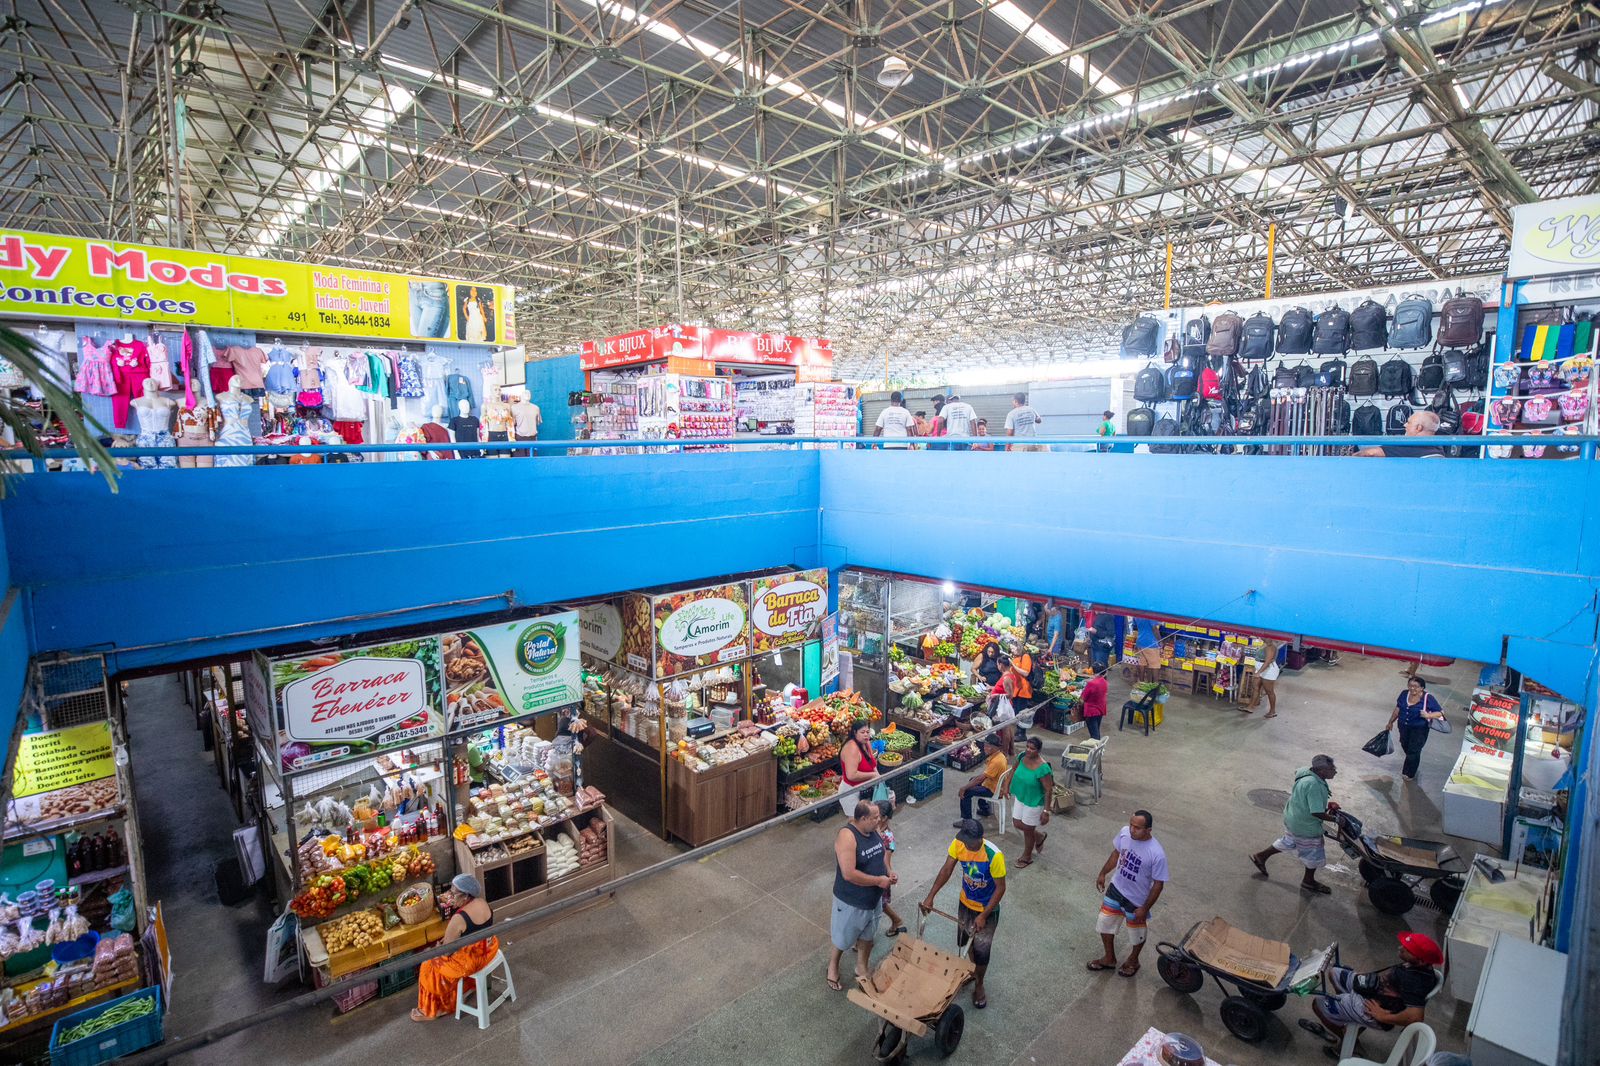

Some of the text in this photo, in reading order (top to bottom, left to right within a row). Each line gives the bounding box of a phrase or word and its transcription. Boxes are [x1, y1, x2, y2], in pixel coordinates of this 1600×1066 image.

[88, 244, 287, 297] Modas
[314, 272, 390, 294] Moda Feminina e
[1549, 276, 1600, 293] RE
[316, 293, 350, 311] Infanto
[359, 297, 390, 314] Juvenil
[288, 311, 307, 323] 491
[342, 313, 391, 328] 3644-1834
[619, 334, 646, 354] BIJUX
[757, 337, 793, 354] BIJUX
[763, 588, 821, 611] Barraca
[594, 612, 608, 625] Life
[722, 613, 735, 622] Life
[769, 605, 816, 628] da Fia
[694, 620, 730, 636] Amorim
[524, 637, 552, 652] Portal
[527, 645, 558, 660] Natural
[312, 671, 410, 699] Barraca
[311, 692, 413, 723] Ebenézer
[1484, 696, 1513, 710] TEMOS
[386, 726, 428, 742] 98242-5340
[1484, 737, 1497, 746] DE
[31, 740, 61, 750] Buriti
[33, 745, 77, 758] Goiabada
[34, 745, 111, 766] Goiabada Cascão
[35, 761, 69, 774] Banana
[36, 768, 82, 782] Rapadura
[37, 772, 96, 790] Doce de leite
